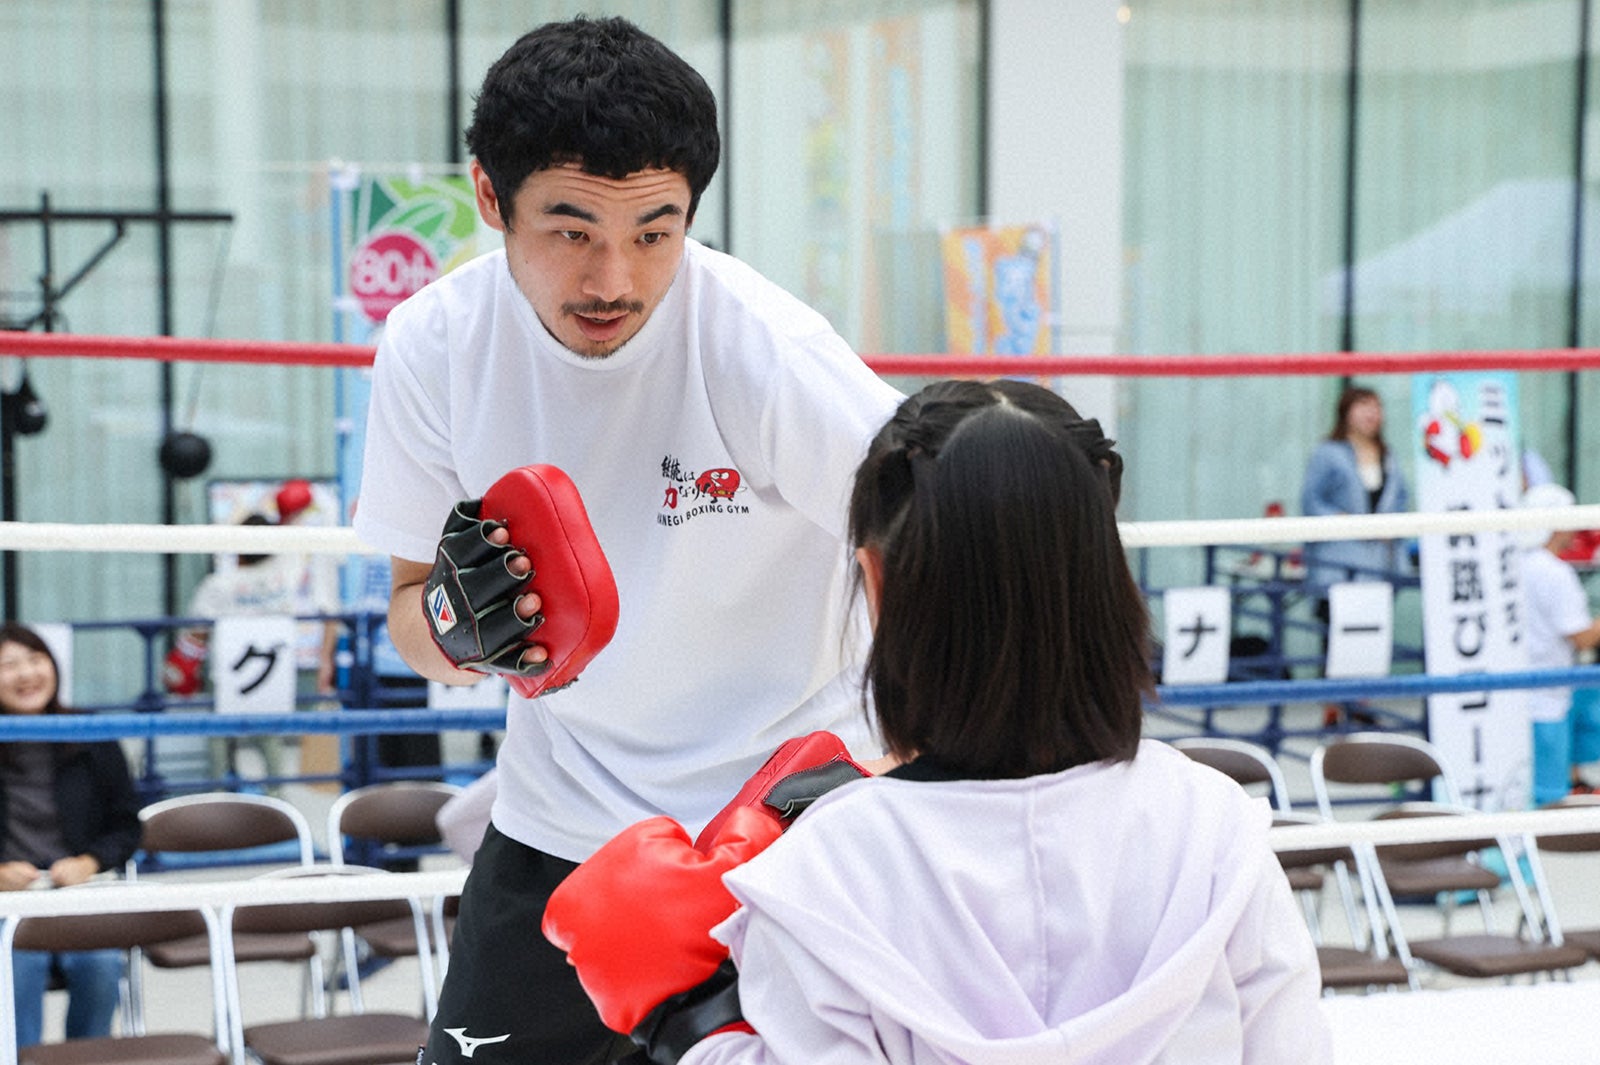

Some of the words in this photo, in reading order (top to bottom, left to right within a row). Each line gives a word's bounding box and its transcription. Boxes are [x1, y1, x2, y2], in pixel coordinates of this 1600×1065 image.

[686, 504, 724, 521] BOXING
[726, 504, 750, 514] GYM
[1177, 613, 1219, 660] ナ
